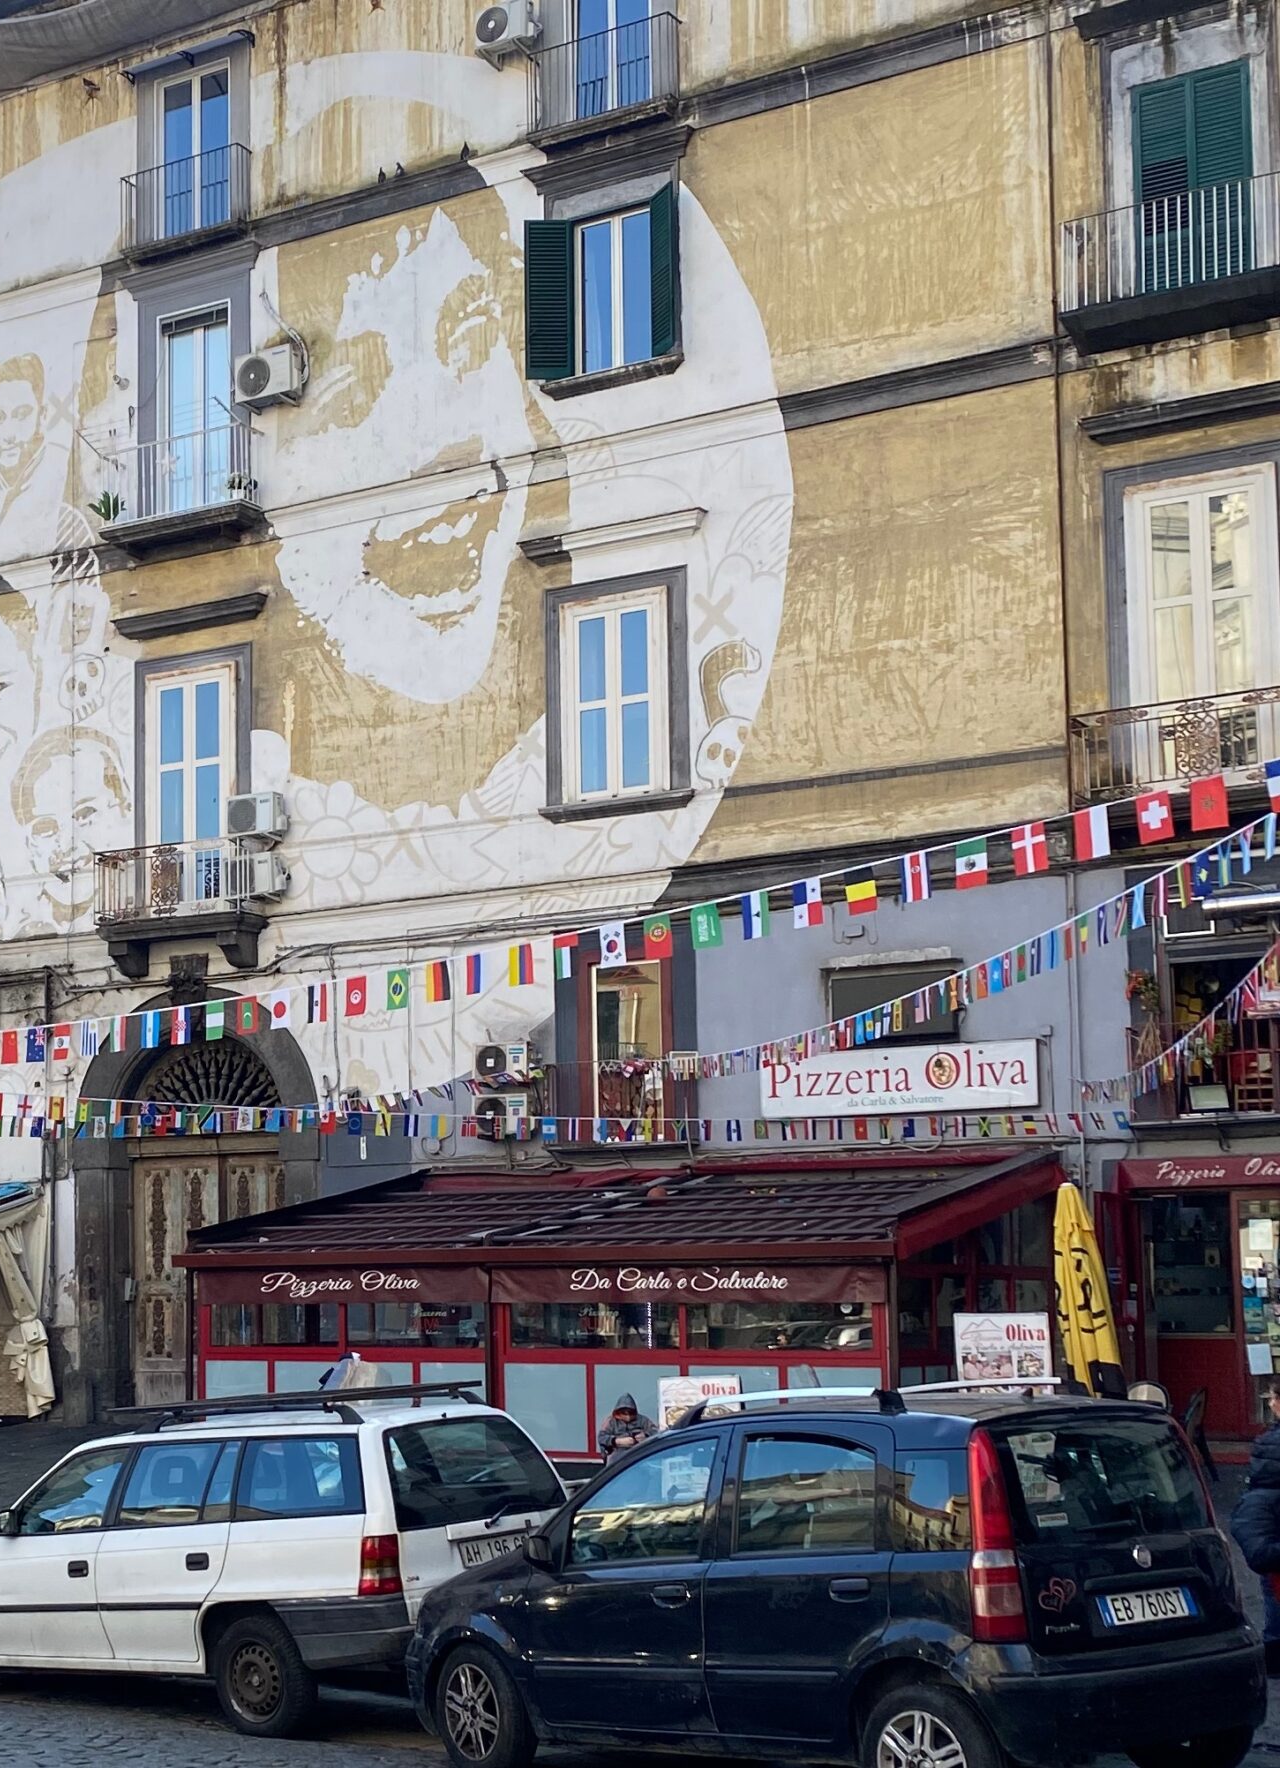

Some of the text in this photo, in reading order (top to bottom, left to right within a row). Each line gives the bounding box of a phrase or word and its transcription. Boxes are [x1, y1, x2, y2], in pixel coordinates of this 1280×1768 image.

[768, 1049, 1029, 1099] Pizzeria Oliva
[847, 1094, 944, 1108] da Carla & Salvatore
[1156, 1160, 1226, 1186] Pizzeria
[261, 1270, 421, 1298] Pizzeria Oliva
[570, 1266, 789, 1291] Da Carla e Salvatore
[1005, 1323, 1046, 1342] Oliva
[701, 1382, 737, 1396] Oliva
[464, 1543, 484, 1564] AH
[1111, 1596, 1135, 1622] EB
